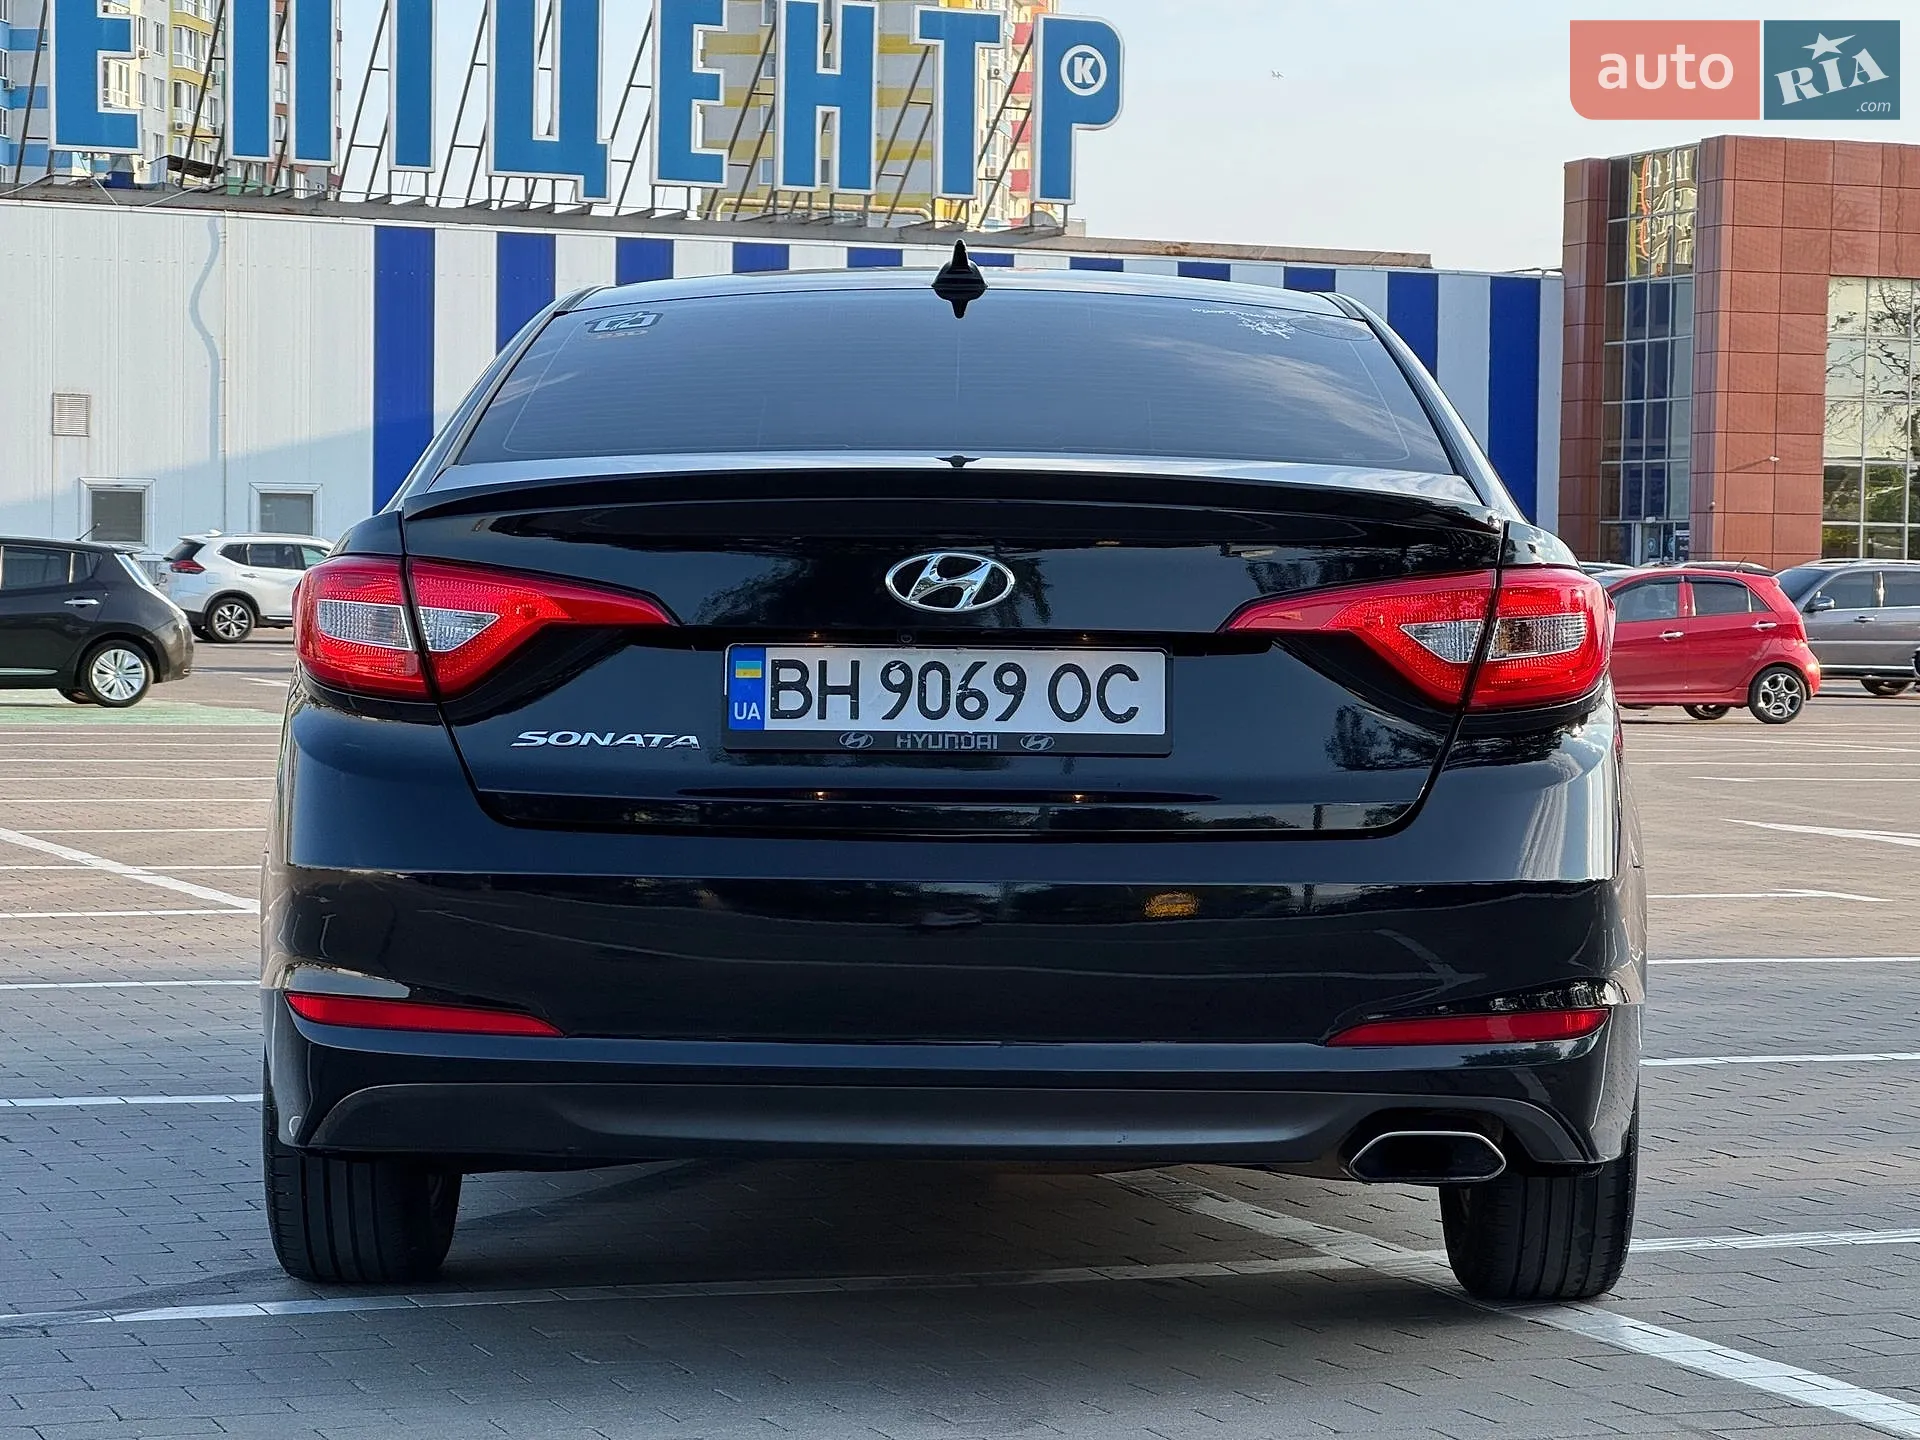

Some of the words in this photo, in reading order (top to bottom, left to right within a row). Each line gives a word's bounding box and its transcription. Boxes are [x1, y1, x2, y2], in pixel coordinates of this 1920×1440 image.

[769, 659, 861, 720] BH
[879, 660, 1027, 722] 9069
[1047, 663, 1140, 724] OC
[734, 702, 761, 720] UA
[510, 731, 701, 749] SONATA
[896, 733, 999, 750] HYUNDAI
